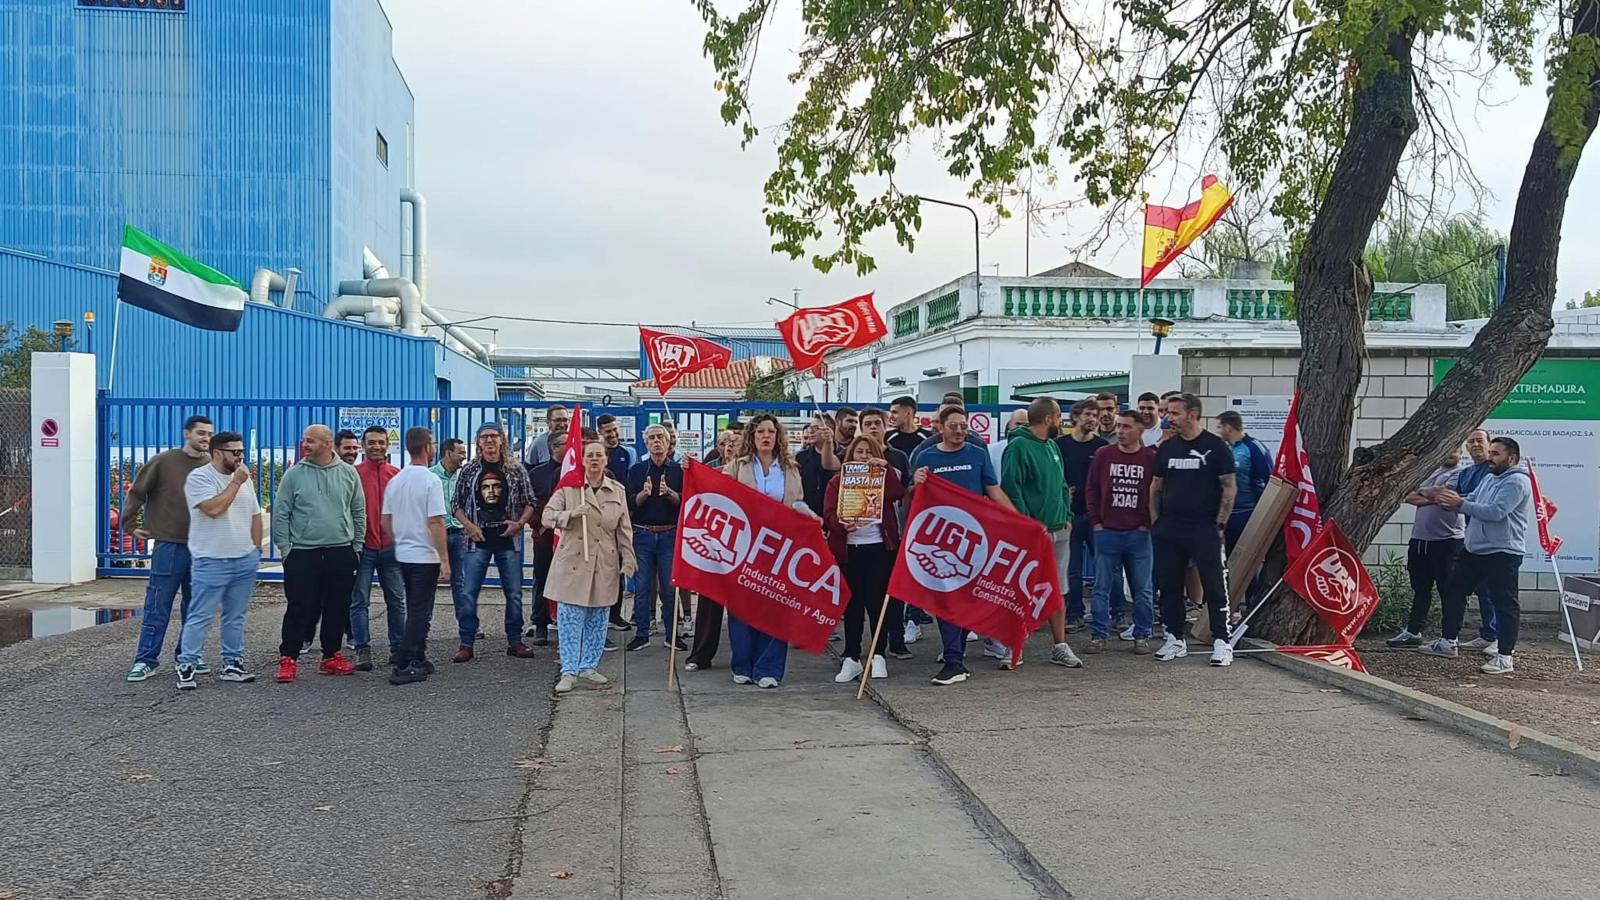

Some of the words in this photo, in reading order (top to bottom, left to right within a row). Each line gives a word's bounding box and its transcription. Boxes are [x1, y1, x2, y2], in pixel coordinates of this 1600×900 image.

[798, 311, 848, 344] UGT
[655, 338, 696, 371] UGT
[1511, 384, 1586, 394] XTREMADURA
[1110, 463, 1145, 479] NEVER
[1168, 458, 1200, 469] PUMA
[1112, 478, 1139, 493] LOOK
[685, 498, 746, 551] UGT
[745, 526, 841, 606] FICA
[914, 512, 983, 564] UGT
[741, 563, 788, 594] Industria,
[737, 574, 802, 611] Construcción
[803, 606, 811, 615] y
[811, 609, 837, 627] Agro
